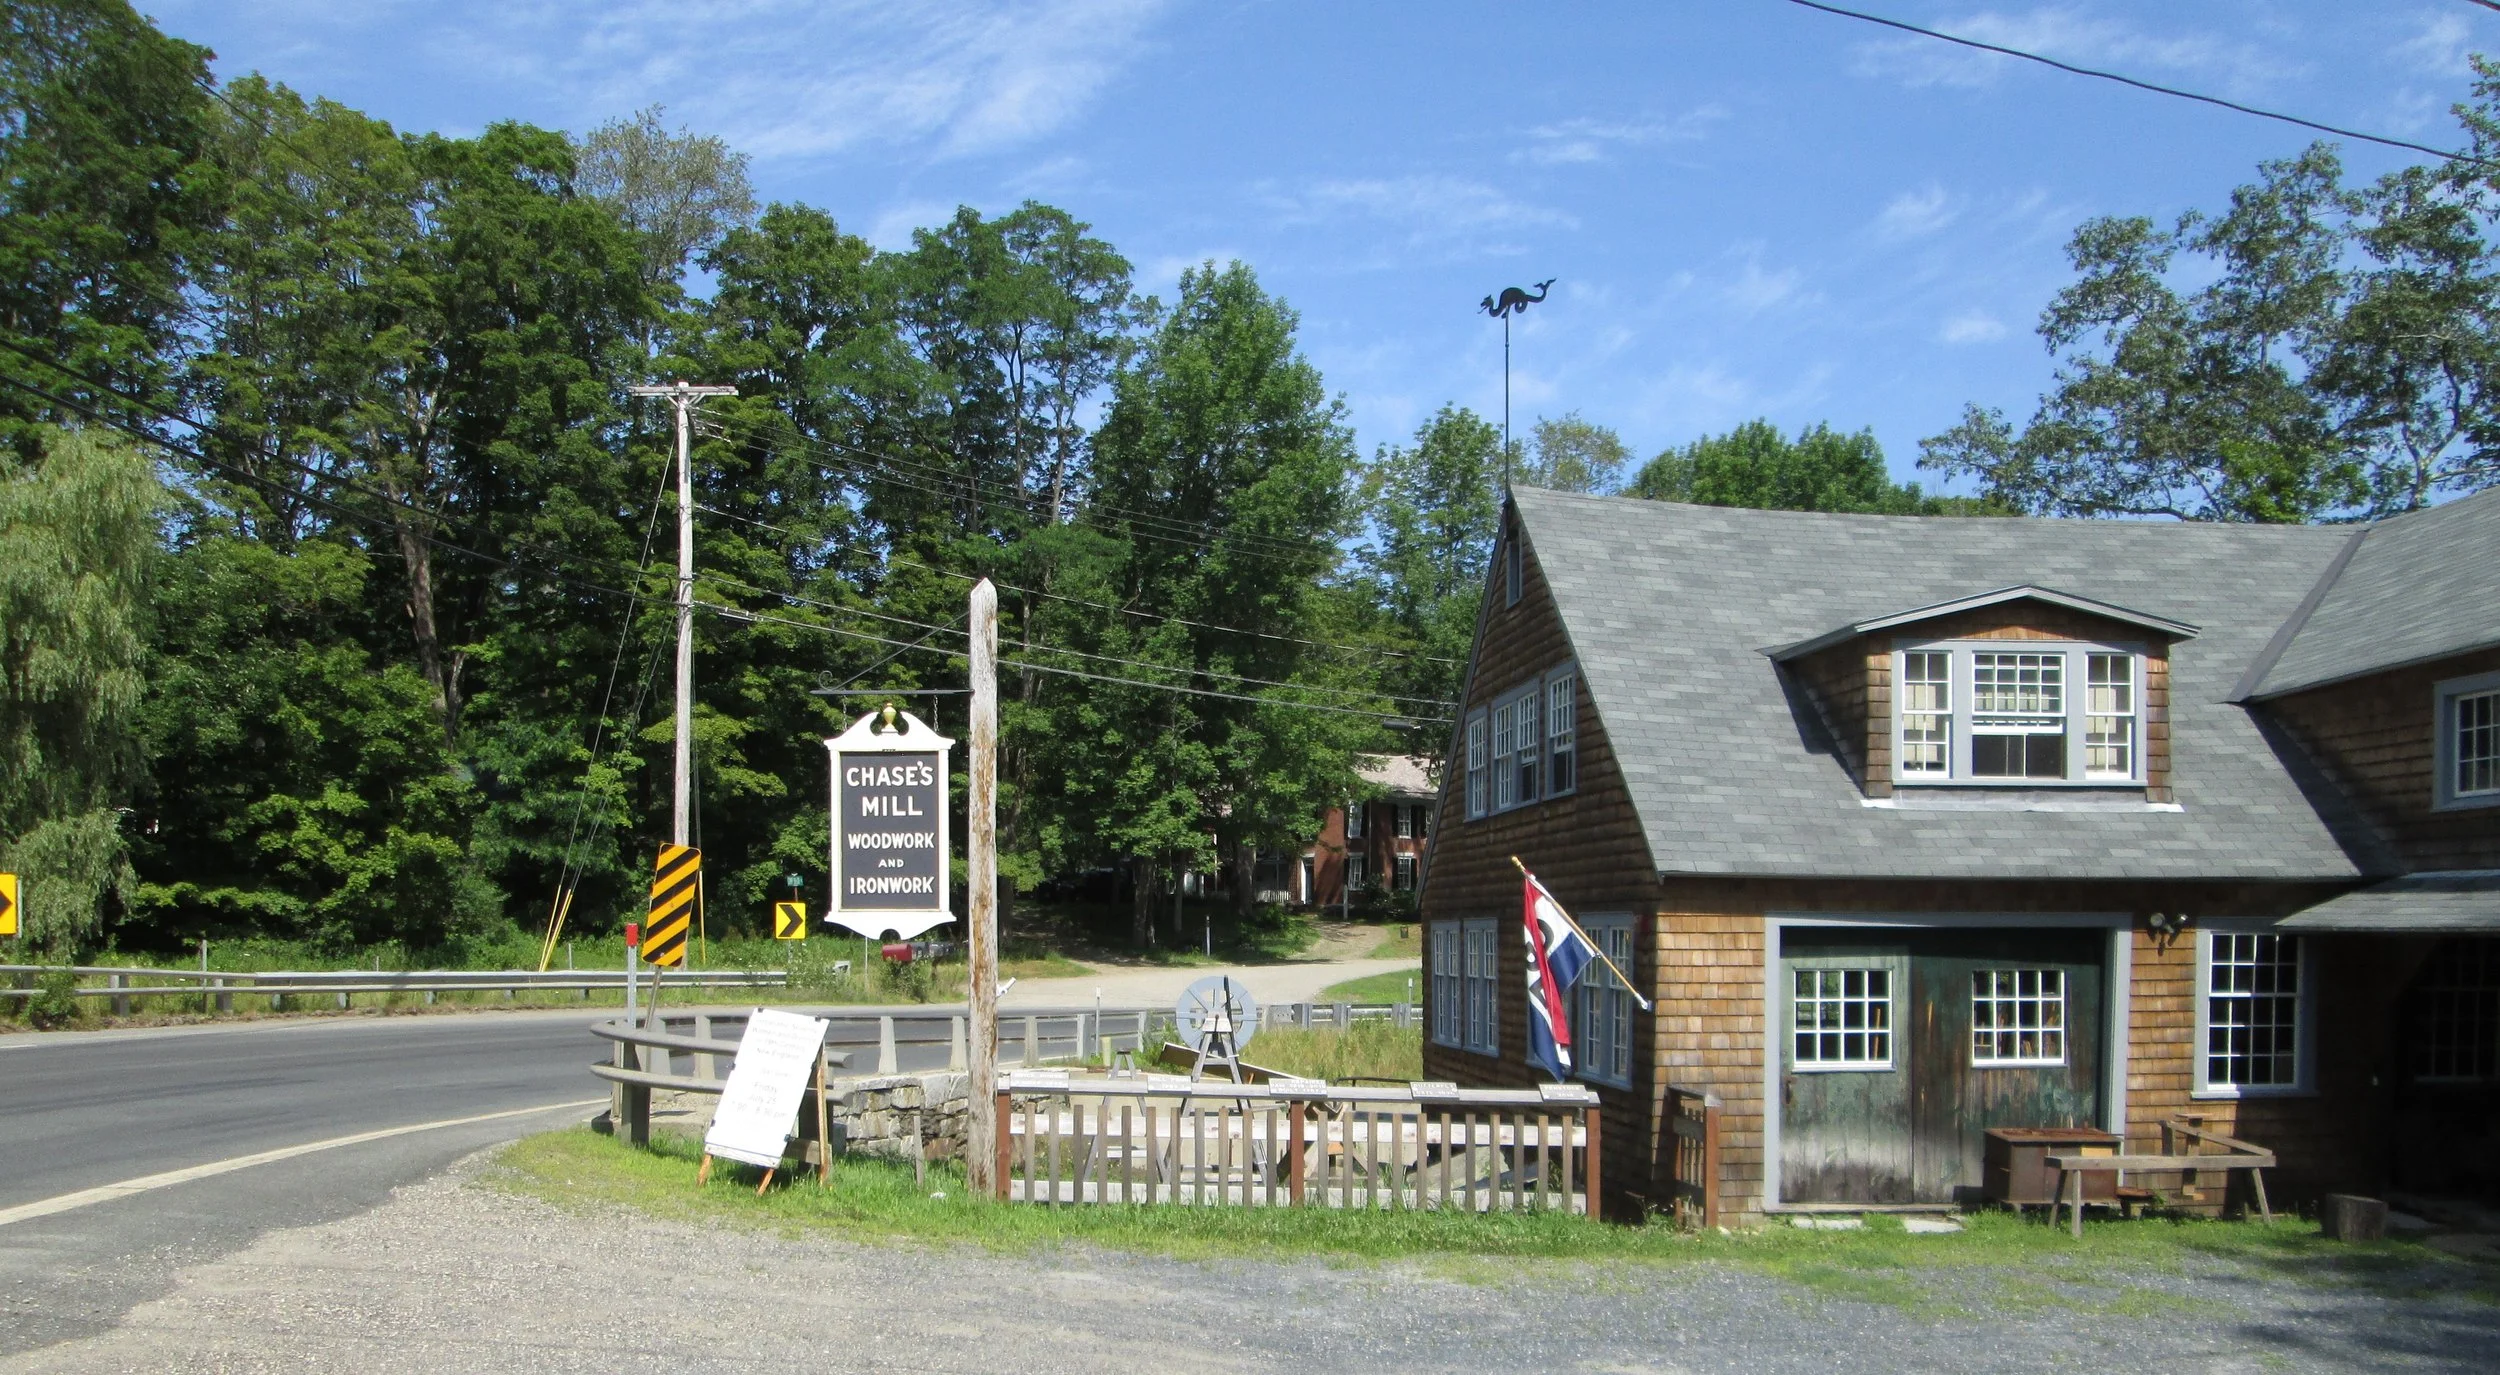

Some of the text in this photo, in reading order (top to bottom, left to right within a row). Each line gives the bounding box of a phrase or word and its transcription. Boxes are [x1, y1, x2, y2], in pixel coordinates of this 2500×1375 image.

[846, 761, 934, 786] CHASE'S
[862, 796, 923, 817] MILL
[847, 832, 935, 850] WOODWORK
[878, 858, 904, 868] AND
[850, 876, 935, 894] IRONWORK
